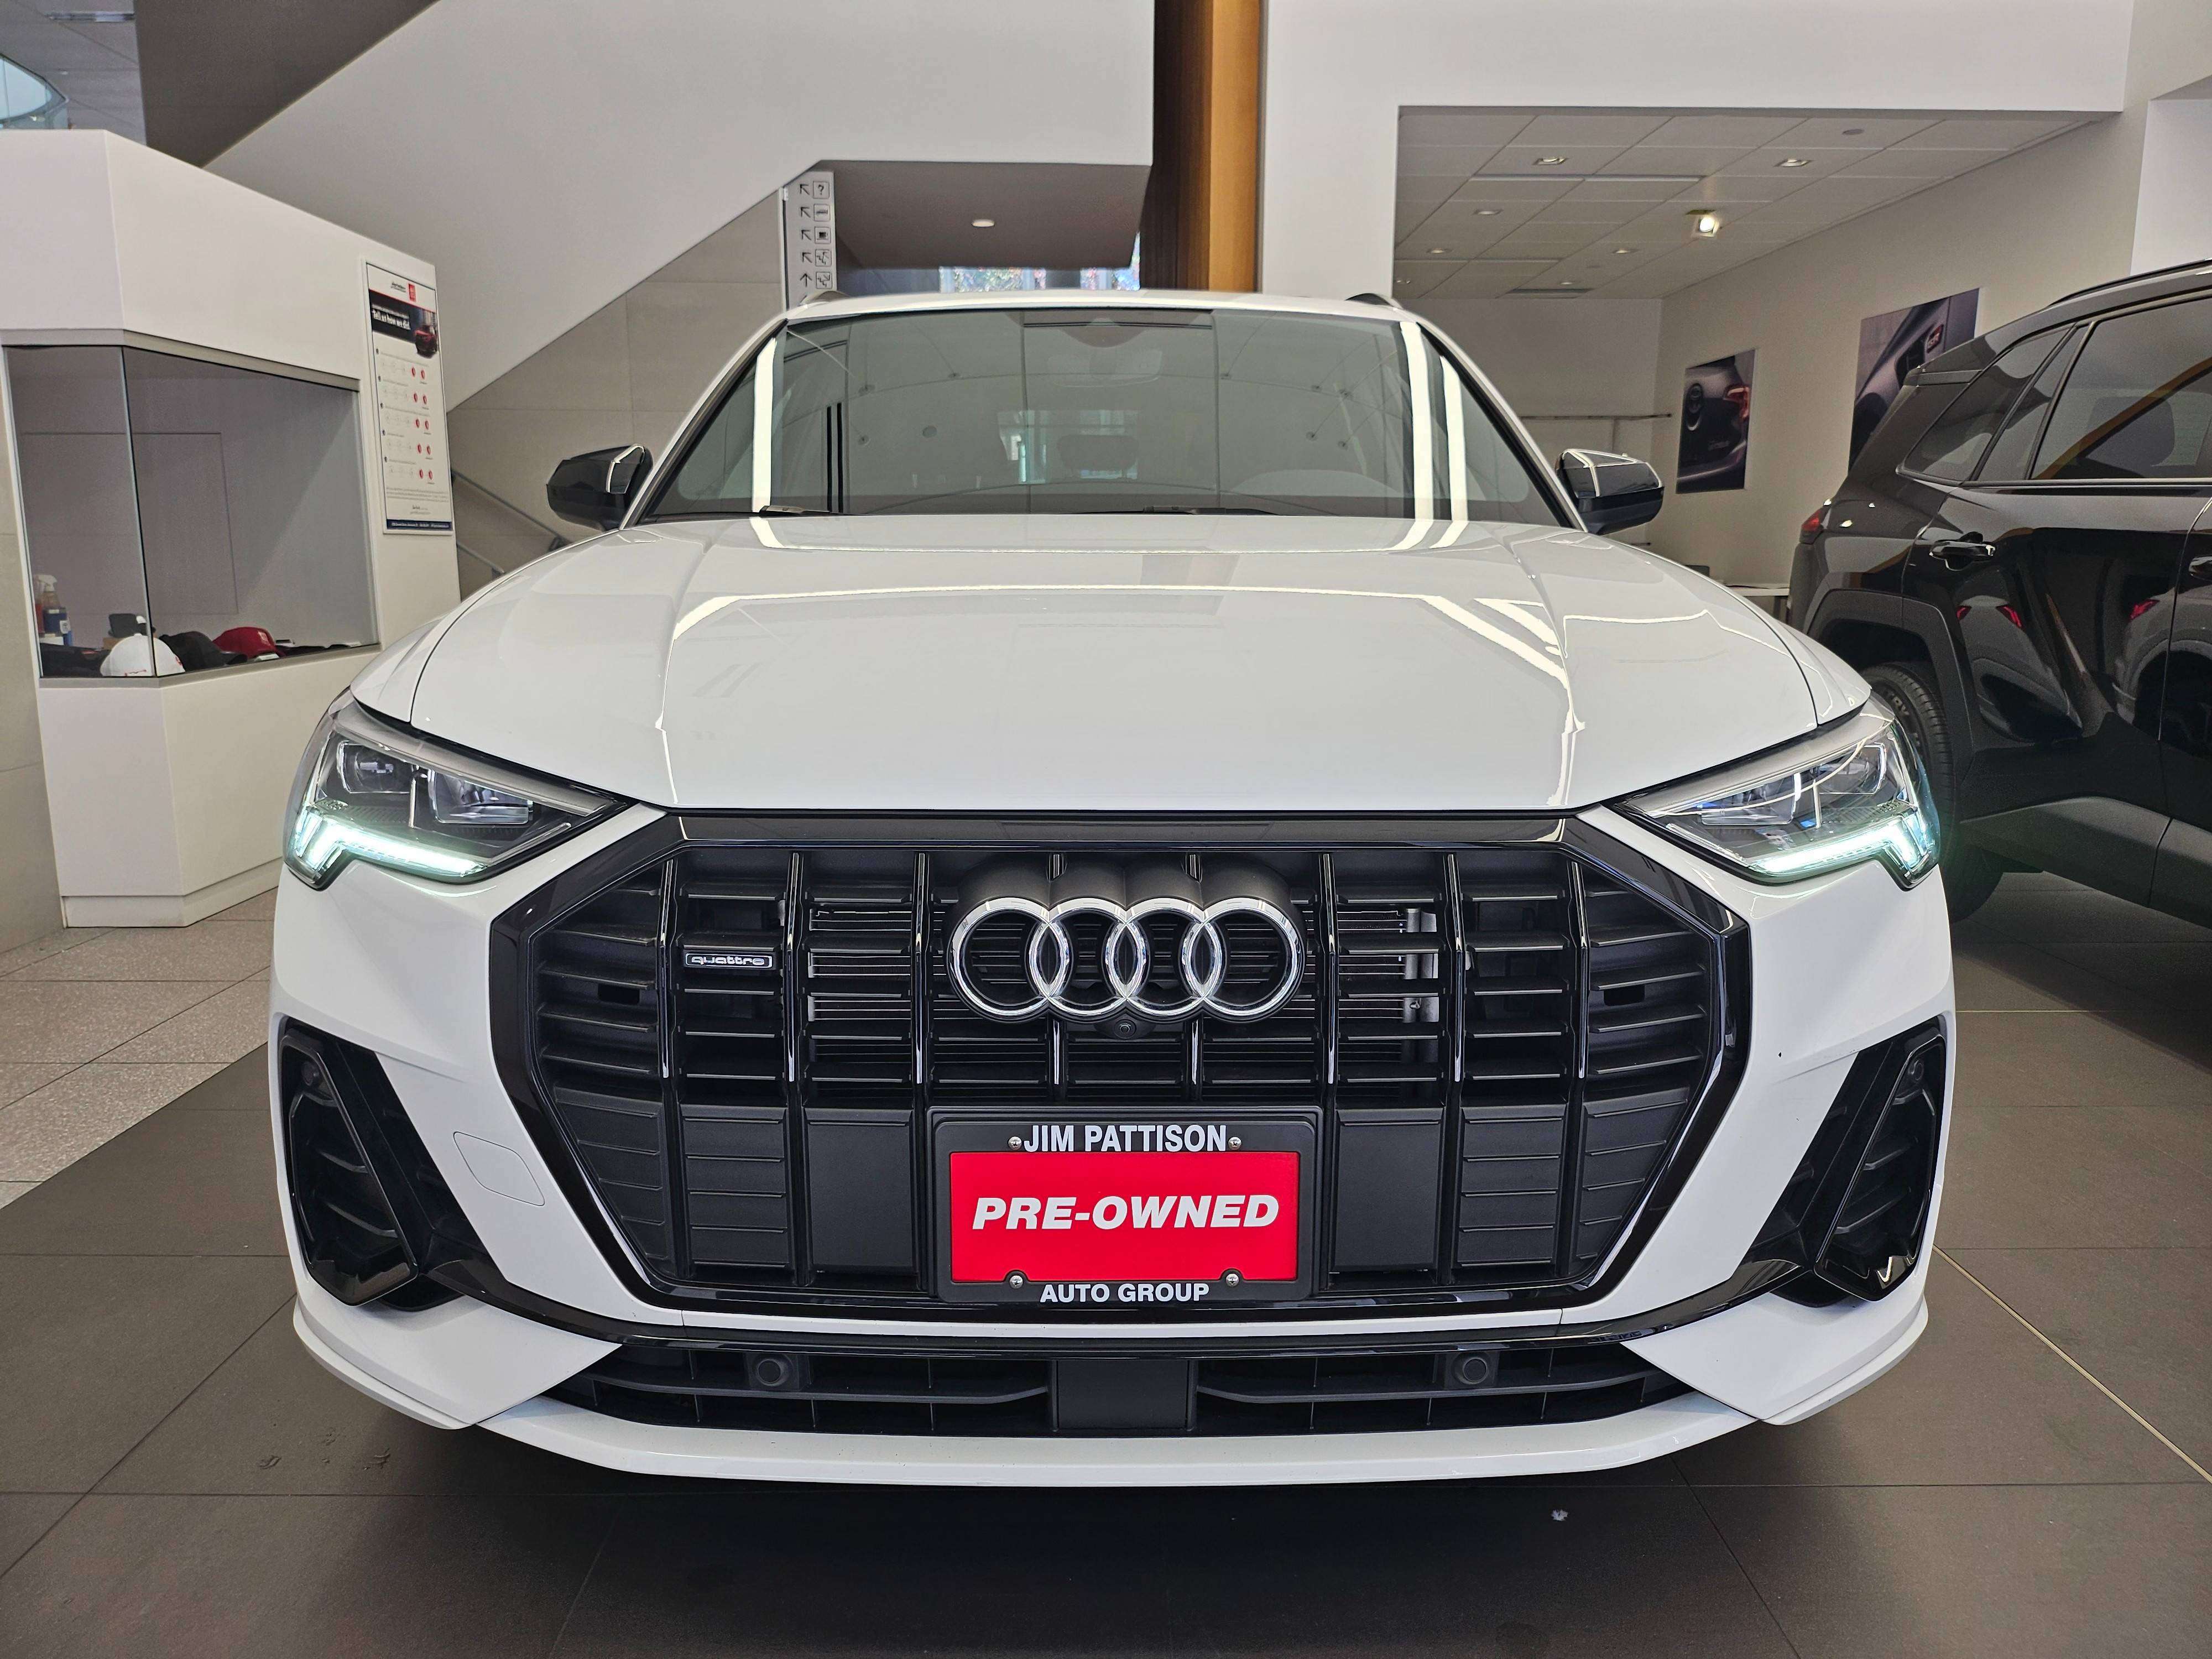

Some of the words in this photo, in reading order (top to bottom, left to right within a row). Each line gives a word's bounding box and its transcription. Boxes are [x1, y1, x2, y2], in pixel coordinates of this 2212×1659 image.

[691, 956, 765, 966] quattro
[1024, 1125, 1074, 1152] JIM
[1084, 1125, 1227, 1152] PATTISON
[972, 1194, 1279, 1230] PRE-OWNED
[1040, 1284, 1110, 1303] AUTO
[1118, 1283, 1209, 1302] GROUP
